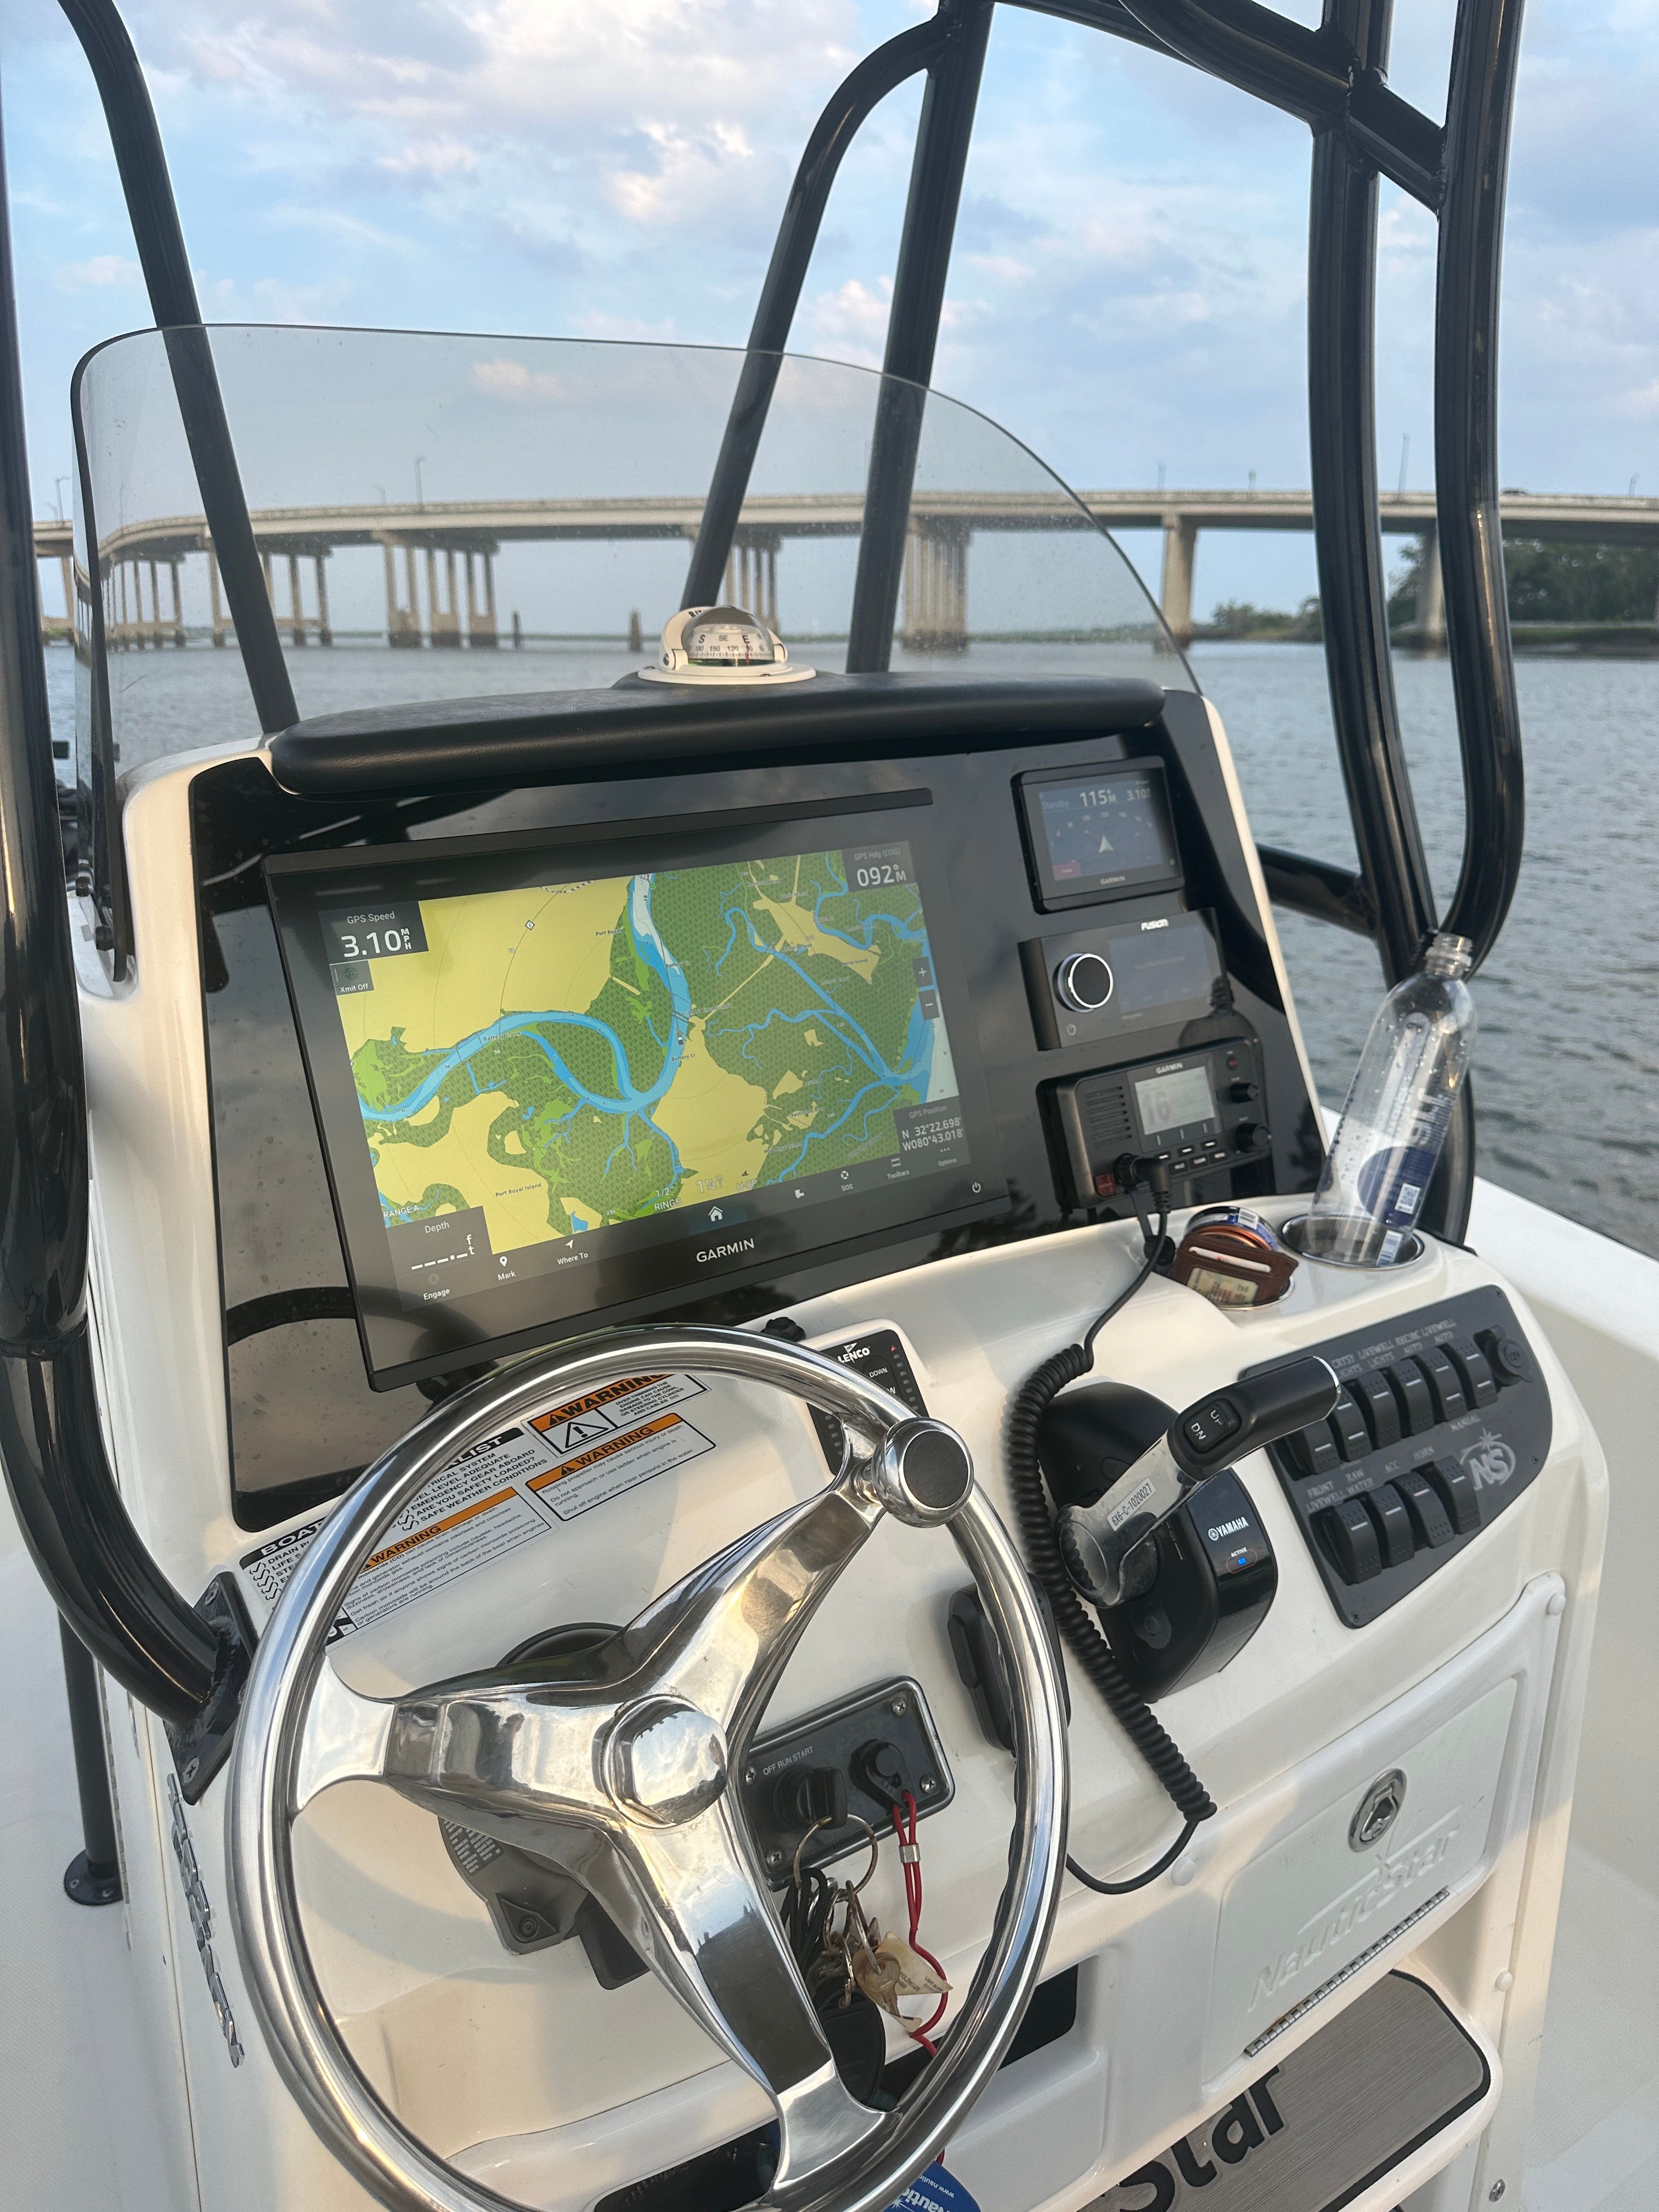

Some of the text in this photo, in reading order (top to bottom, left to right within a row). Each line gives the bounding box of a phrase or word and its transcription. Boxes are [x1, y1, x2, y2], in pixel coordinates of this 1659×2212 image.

[699, 635, 706, 643] S
[869, 851, 882, 859] Hdg
[1100, 876, 1125, 884] GARMIN
[347, 911, 396, 924] GPS Speed
[1141, 919, 1169, 930] FUSION
[341, 930, 402, 957] 3.10
[1156, 1062, 1183, 1074] GARMIN
[909, 1105, 947, 1119] GPS Position
[902, 1130, 909, 1139] N
[938, 1158, 957, 1166] Options
[887, 1170, 910, 1180] Toolbars
[841, 1183, 853, 1192] SOS
[383, 1206, 411, 1218] RANGE
[654, 1198, 681, 1211] RINGS
[425, 1221, 450, 1233] Depth
[696, 1238, 755, 1262] GARMIN
[557, 1256, 578, 1265] Where
[498, 1271, 516, 1280] Mark
[424, 1289, 450, 1300] Engage
[1357, 1340, 1395, 1359] LIVEWELL
[1421, 1318, 1457, 1336] LIVEWELL
[838, 1347, 870, 1363] LENCO
[1368, 1331, 1453, 1368] LIGHTS AUTO AUTO
[869, 1367, 888, 1378] DOWN
[620, 1385, 672, 1408] ENGINE CAUSE
[630, 1388, 684, 1413] STEERING CYLINDER
[631, 1386, 657, 1398] TRIMMING
[620, 1401, 643, 1412] DAMAGE
[646, 1399, 668, 1409] CABLES
[1211, 1410, 1223, 1425] UP
[1451, 1414, 1480, 1432] MANUAL
[1192, 1423, 1206, 1440] DN
[577, 1427, 654, 1465] WARNING
[1413, 1446, 1435, 1461] HORN
[460, 1453, 496, 1472] SYSTEM
[541, 1435, 660, 1494] Rotating propeller may cause serious injury
[571, 1478, 598, 1493] approach
[617, 1457, 636, 1470] ladder
[636, 1451, 651, 1460] when
[652, 1442, 671, 1455] engine
[1385, 1460, 1399, 1472] ACC
[411, 1449, 535, 1510] EMERGENCY GEAR ABOARD
[433, 1454, 510, 1492] LEVEL ADEQUATE
[1346, 1468, 1364, 1482] RAW
[416, 1457, 535, 1516] ARE YOU SAFETY LOADED?
[420, 1459, 548, 1521] SAFE WEATHER CONDITIONS
[563, 1463, 661, 1514] Shut engine when near persons
[1307, 1478, 1374, 1498] FRONT WATER
[554, 1493, 579, 1506] running.
[1111, 1483, 1152, 1526] 6X6-C-1020027
[1305, 1490, 1343, 1513] LIVEWELL
[1217, 1516, 1249, 1537] YAMAHA
[261, 1521, 323, 1555] BOAT
[371, 1526, 442, 1564] WARNING
[373, 1508, 511, 1582] generator exhaust contains odorless colorless
[268, 1547, 298, 1564] DRAIN
[358, 1519, 473, 1579] monoxide (CO) cause brain damage
[1231, 1547, 1246, 1558] ACTIVE
[272, 1558, 294, 1570] LIFE
[355, 1522, 544, 1622] Carbon monoxide around engines
[394, 1533, 507, 1595] anyone carbon monoxide
[344, 1595, 361, 1607] Signs
[370, 1581, 390, 1593] carbon
[392, 1566, 420, 1582] monoxide
[421, 1551, 449, 1568] poisoning
[362, 1574, 390, 1590] monoxide
[365, 1585, 433, 1622] generators running
[763, 1746, 814, 1775] OFF RUN START
[1247, 1824, 1460, 2014] NauticStar
